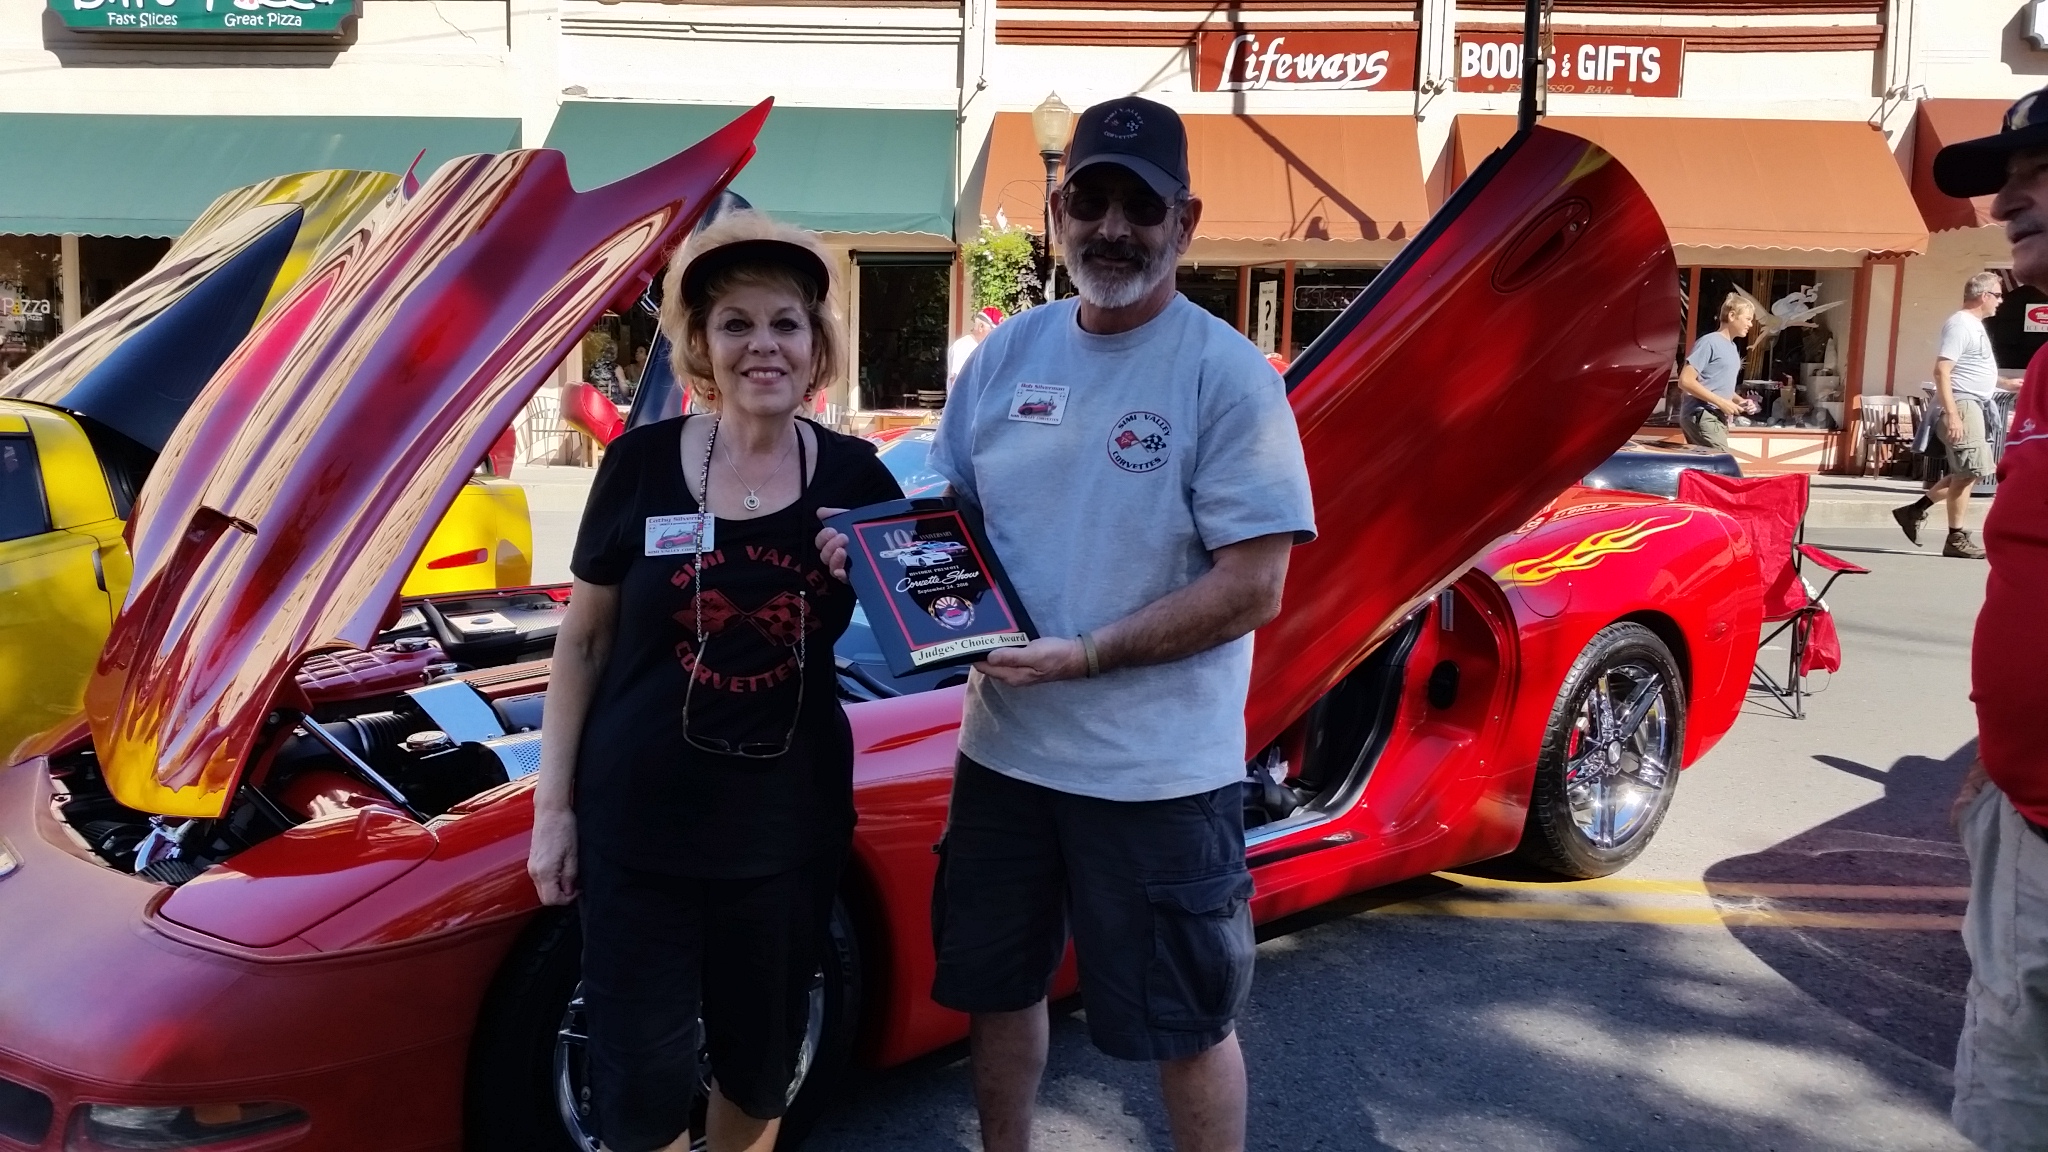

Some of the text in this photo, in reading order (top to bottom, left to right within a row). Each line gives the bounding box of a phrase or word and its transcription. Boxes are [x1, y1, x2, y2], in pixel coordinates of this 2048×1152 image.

[107, 13, 178, 27] Fast Slices
[224, 13, 302, 26] Great Pizza
[1216, 34, 1390, 91] Lifeways
[1562, 53, 1571, 78] &
[1577, 44, 1661, 83] GIFTS
[1584, 85, 1613, 94] BAR
[1118, 414, 1170, 436] SIMI VALLEY
[1112, 450, 1162, 470] CORVETTES
[882, 528, 913, 550] 10
[895, 569, 980, 593] Corvette Show
[917, 586, 946, 595] September
[918, 632, 1026, 661] Judges' Choice Award
